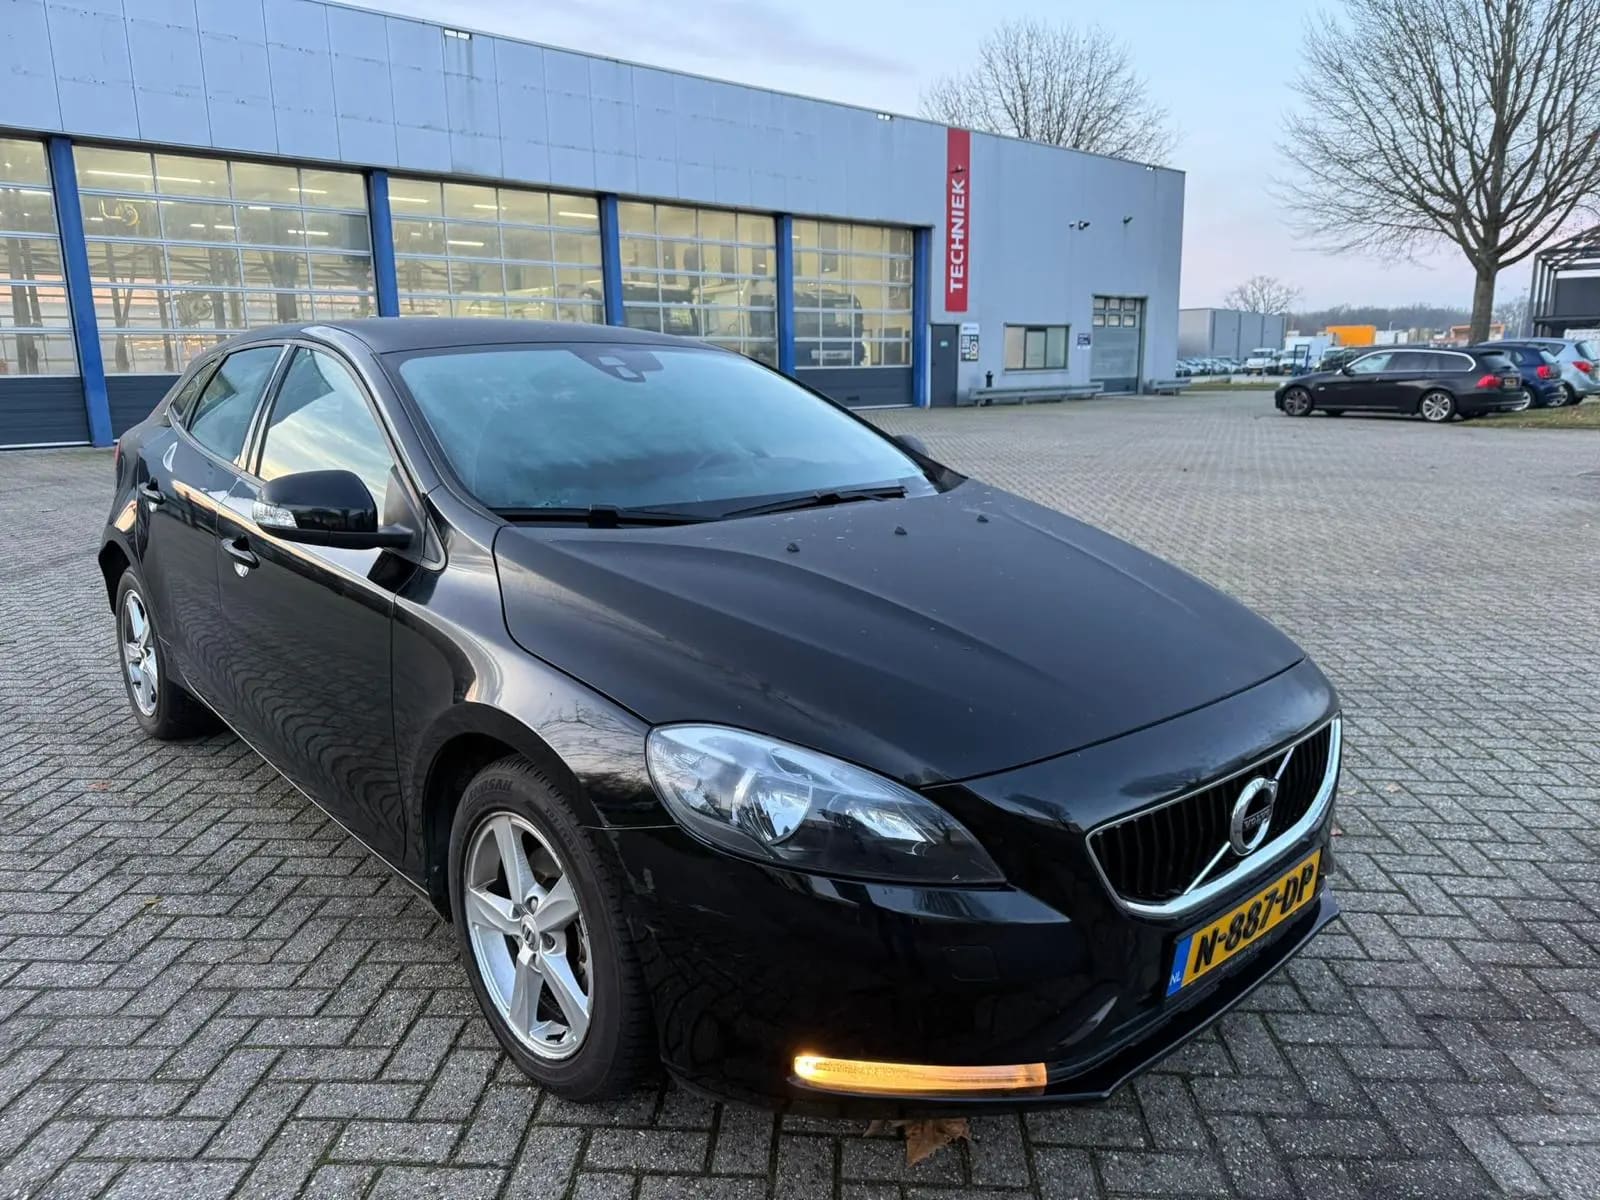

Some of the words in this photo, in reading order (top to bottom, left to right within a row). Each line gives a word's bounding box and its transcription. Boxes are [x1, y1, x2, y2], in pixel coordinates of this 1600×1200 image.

[950, 178, 966, 293] TECHNIEK
[1244, 808, 1271, 829] VOLVO
[1193, 863, 1314, 974] N-887-DP
[1169, 971, 1181, 986] NL
